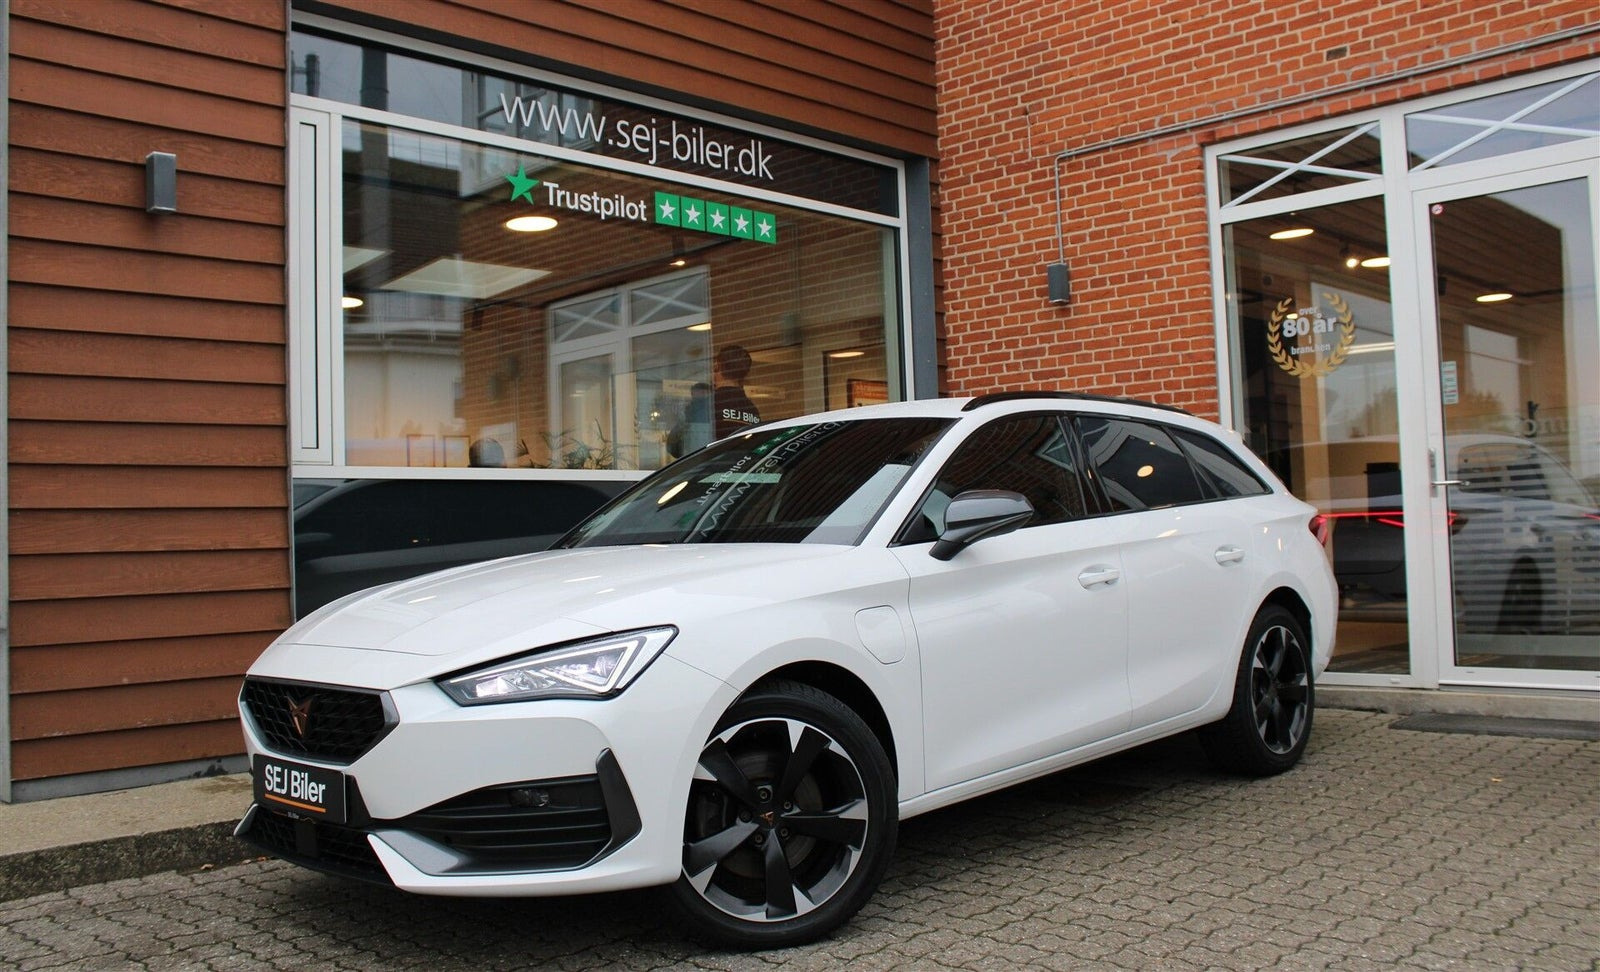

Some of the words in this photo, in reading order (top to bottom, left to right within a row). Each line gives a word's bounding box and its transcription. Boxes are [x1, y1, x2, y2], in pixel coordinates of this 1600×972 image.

[500, 92, 773, 180] www.sej-biler.dk
[543, 180, 647, 221] Trustpilot
[1282, 317, 1310, 338] 80
[1312, 313, 1337, 333] år
[722, 408, 741, 420] SEJ
[264, 763, 288, 795] SEJ
[290, 770, 326, 804] Biler
